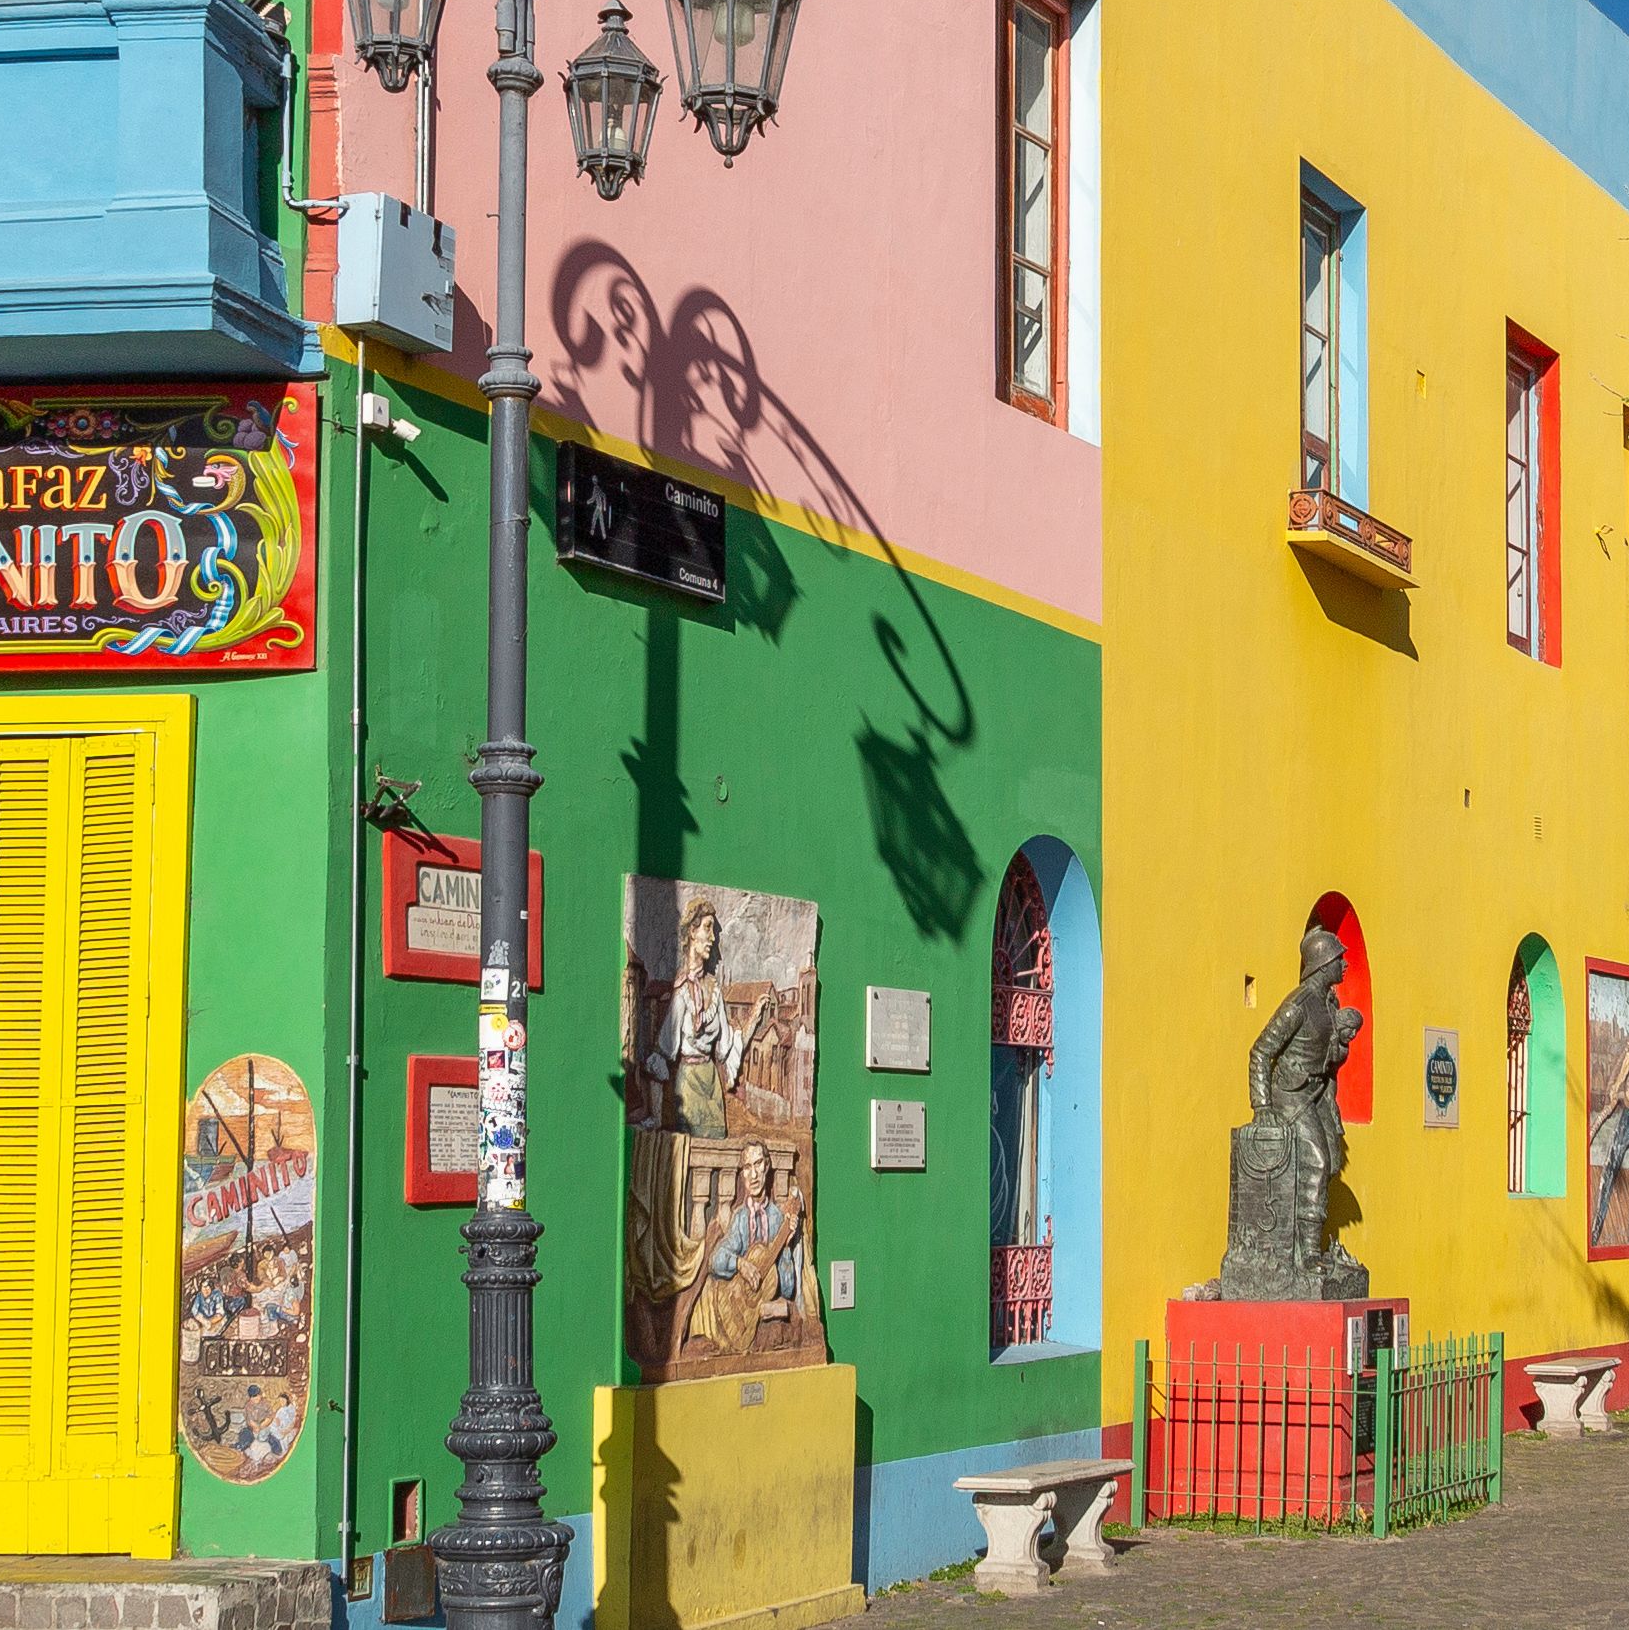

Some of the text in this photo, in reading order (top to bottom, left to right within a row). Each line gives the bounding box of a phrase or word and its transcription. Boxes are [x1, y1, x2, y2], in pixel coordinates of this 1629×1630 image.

[665, 482, 718, 518] Caminito
[679, 567, 718, 590] Comuna 4
[420, 871, 479, 910] CAMIN
[467, 914, 480, 931] Dio
[186, 1150, 308, 1227] CAMINITO
